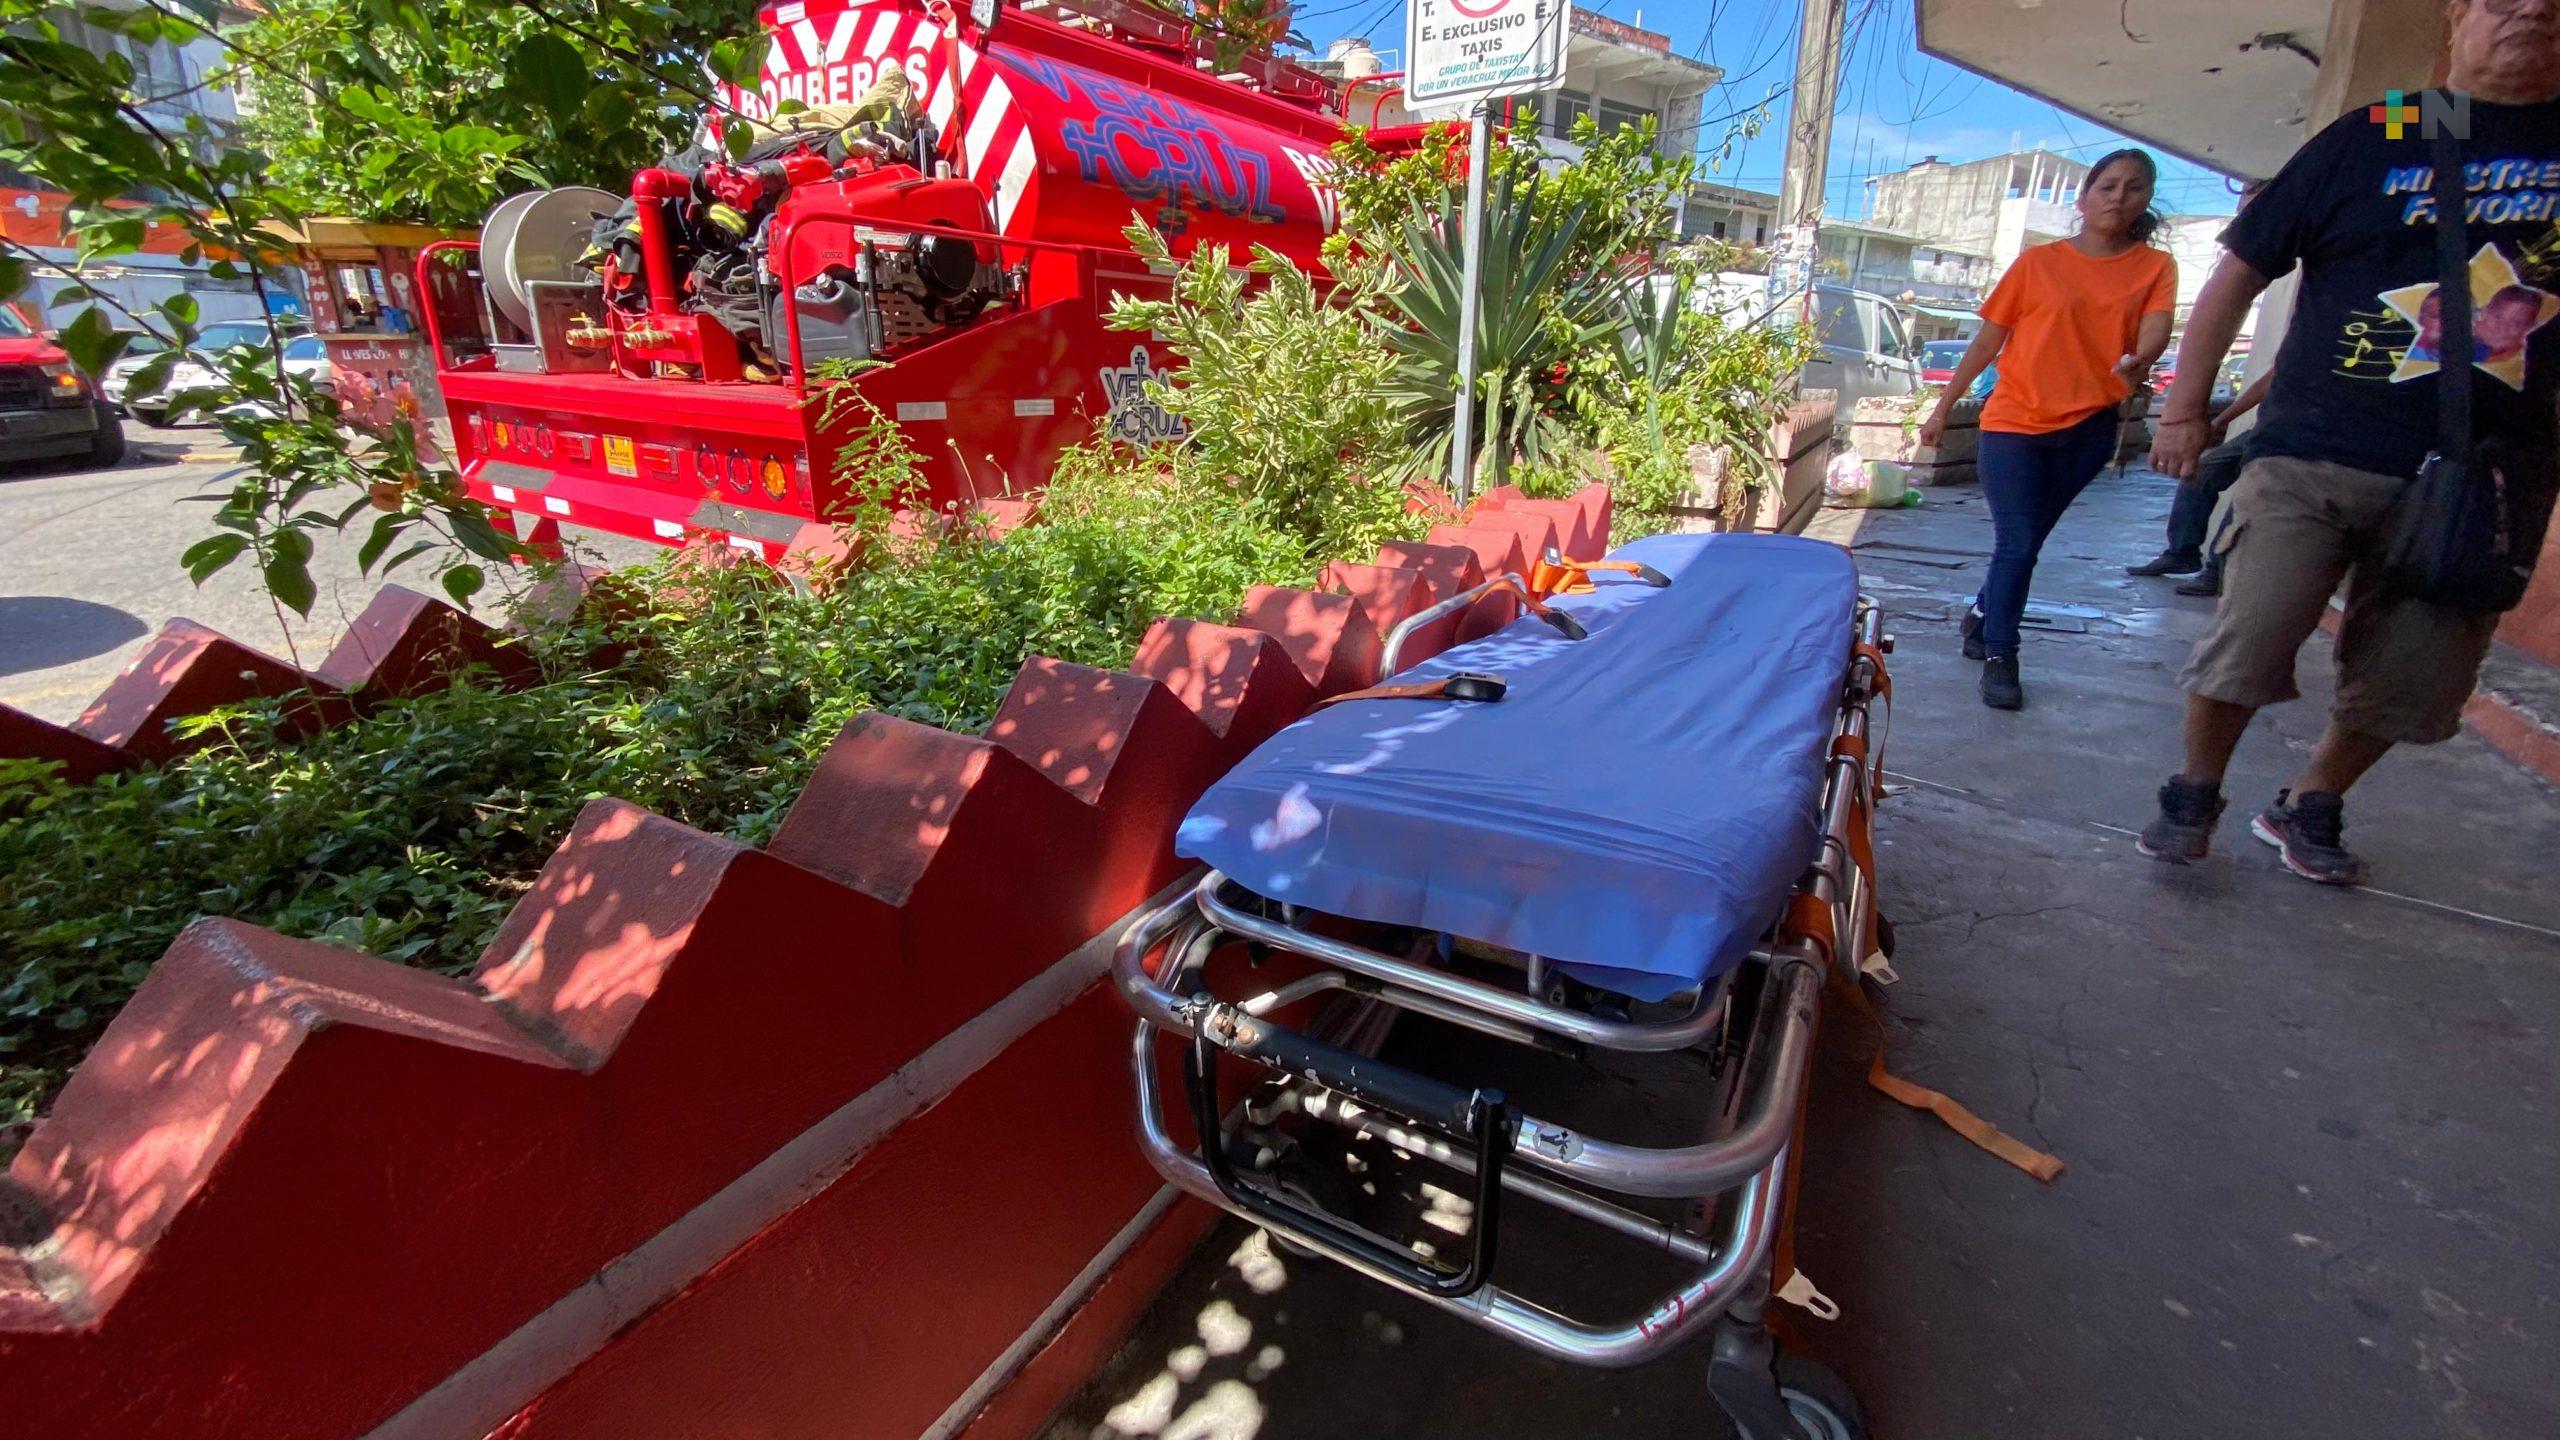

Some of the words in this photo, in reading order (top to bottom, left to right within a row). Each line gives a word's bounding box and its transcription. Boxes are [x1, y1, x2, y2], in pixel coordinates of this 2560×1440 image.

[1442, 13, 1526, 41] EXCLUSIVO
[1461, 38, 1503, 57] TAXIS
[1438, 63, 1468, 77] GRUPO
[1468, 60, 1481, 70] DE
[1418, 80, 1435, 93] POR
[1436, 78, 1449, 89] UN
[1450, 71, 1496, 88] VERACRUZ
